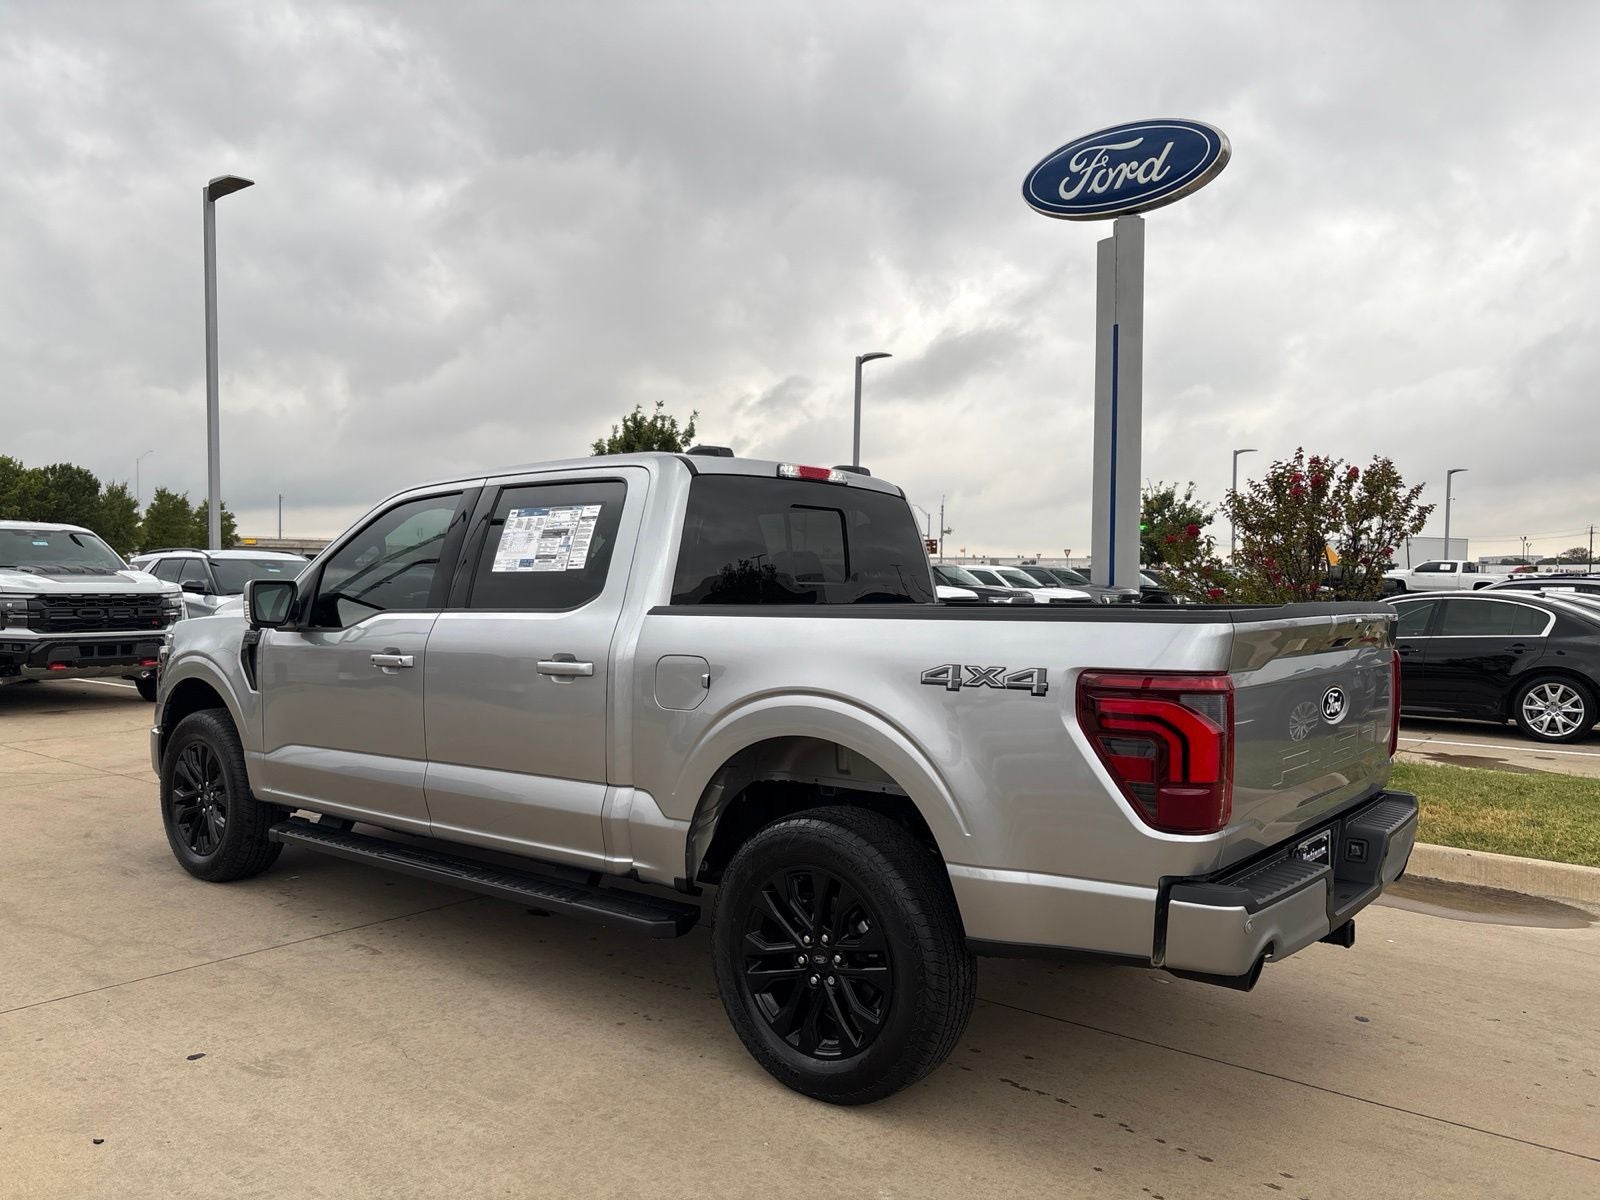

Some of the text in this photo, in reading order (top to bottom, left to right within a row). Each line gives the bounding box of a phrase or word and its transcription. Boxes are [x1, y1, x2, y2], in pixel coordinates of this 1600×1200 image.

[1059, 137, 1174, 200] Ford
[1326, 692, 1342, 714] Ford
[1272, 720, 1378, 787] F-150
